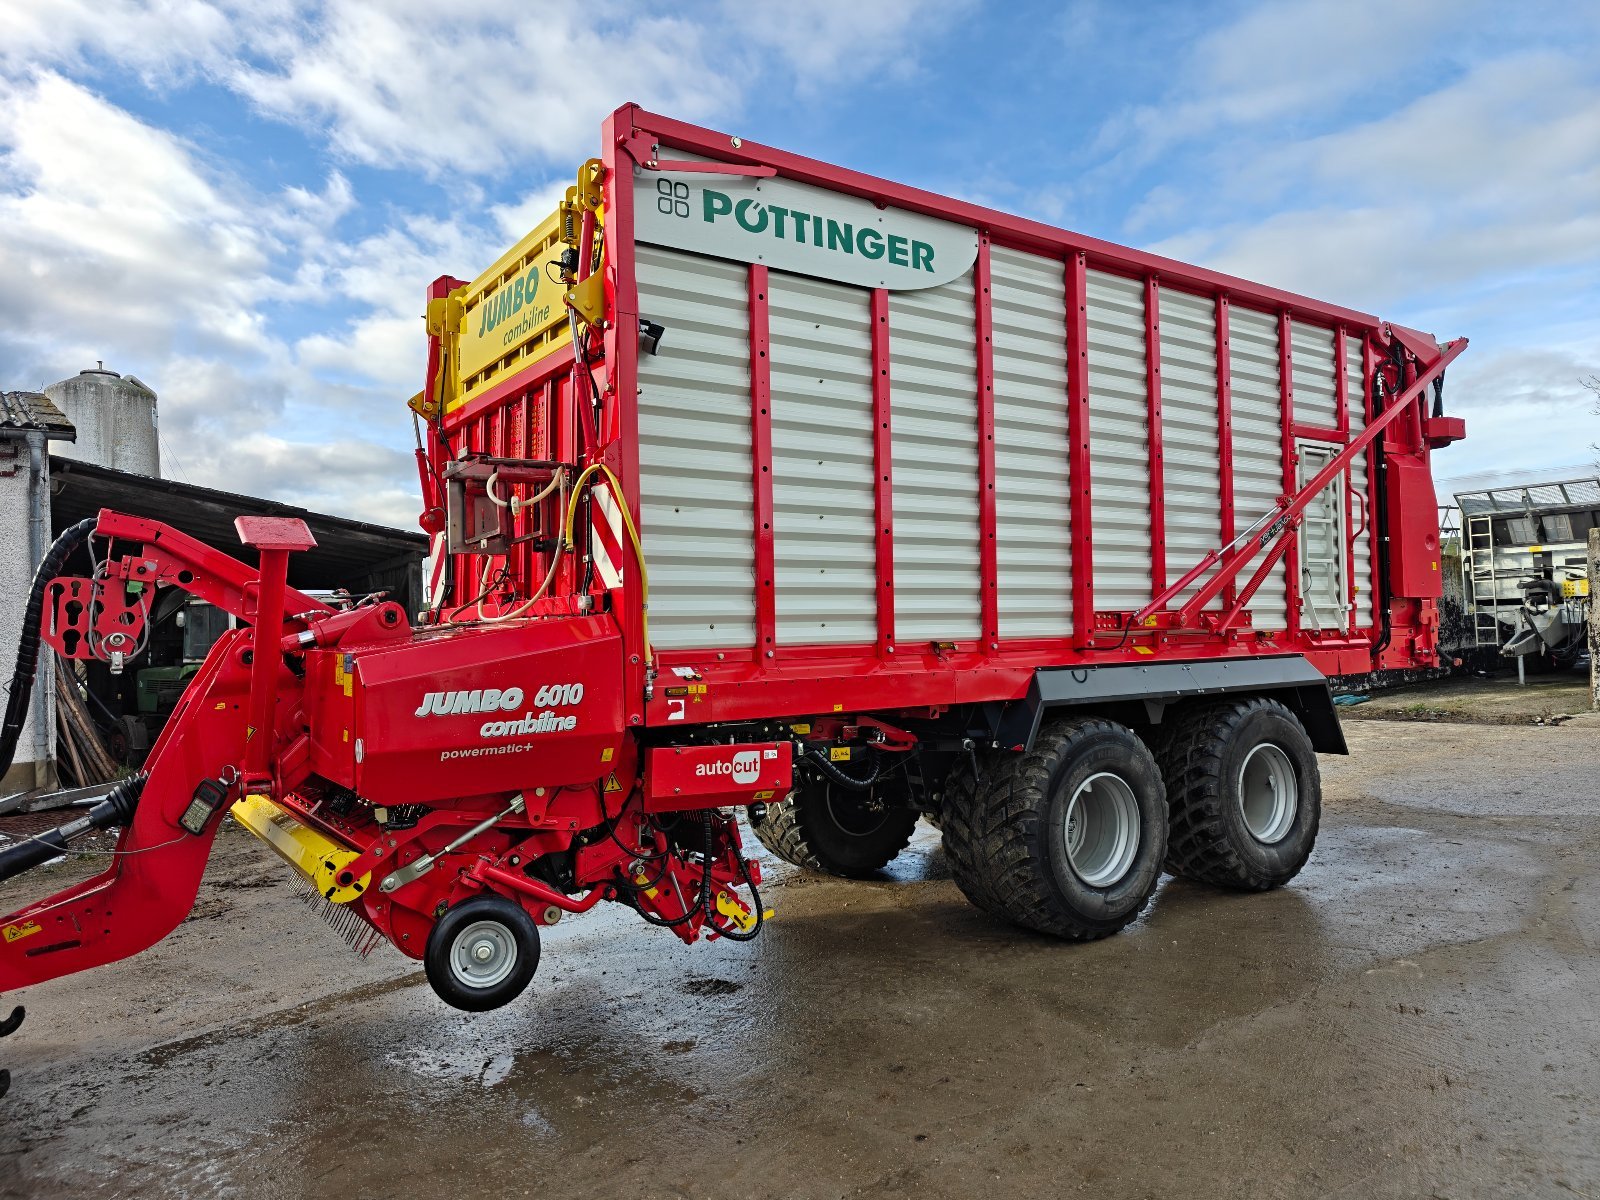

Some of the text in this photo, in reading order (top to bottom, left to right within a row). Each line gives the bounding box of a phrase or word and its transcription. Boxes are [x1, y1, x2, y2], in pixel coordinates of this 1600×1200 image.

[703, 189, 935, 273] PÖTTINGER
[478, 266, 540, 338] JUMBO
[503, 303, 550, 346] combiline
[415, 683, 584, 717] JUMBO 6010
[480, 711, 577, 738] combiline
[440, 742, 534, 761] powermatic+
[695, 756, 759, 776] autocut
